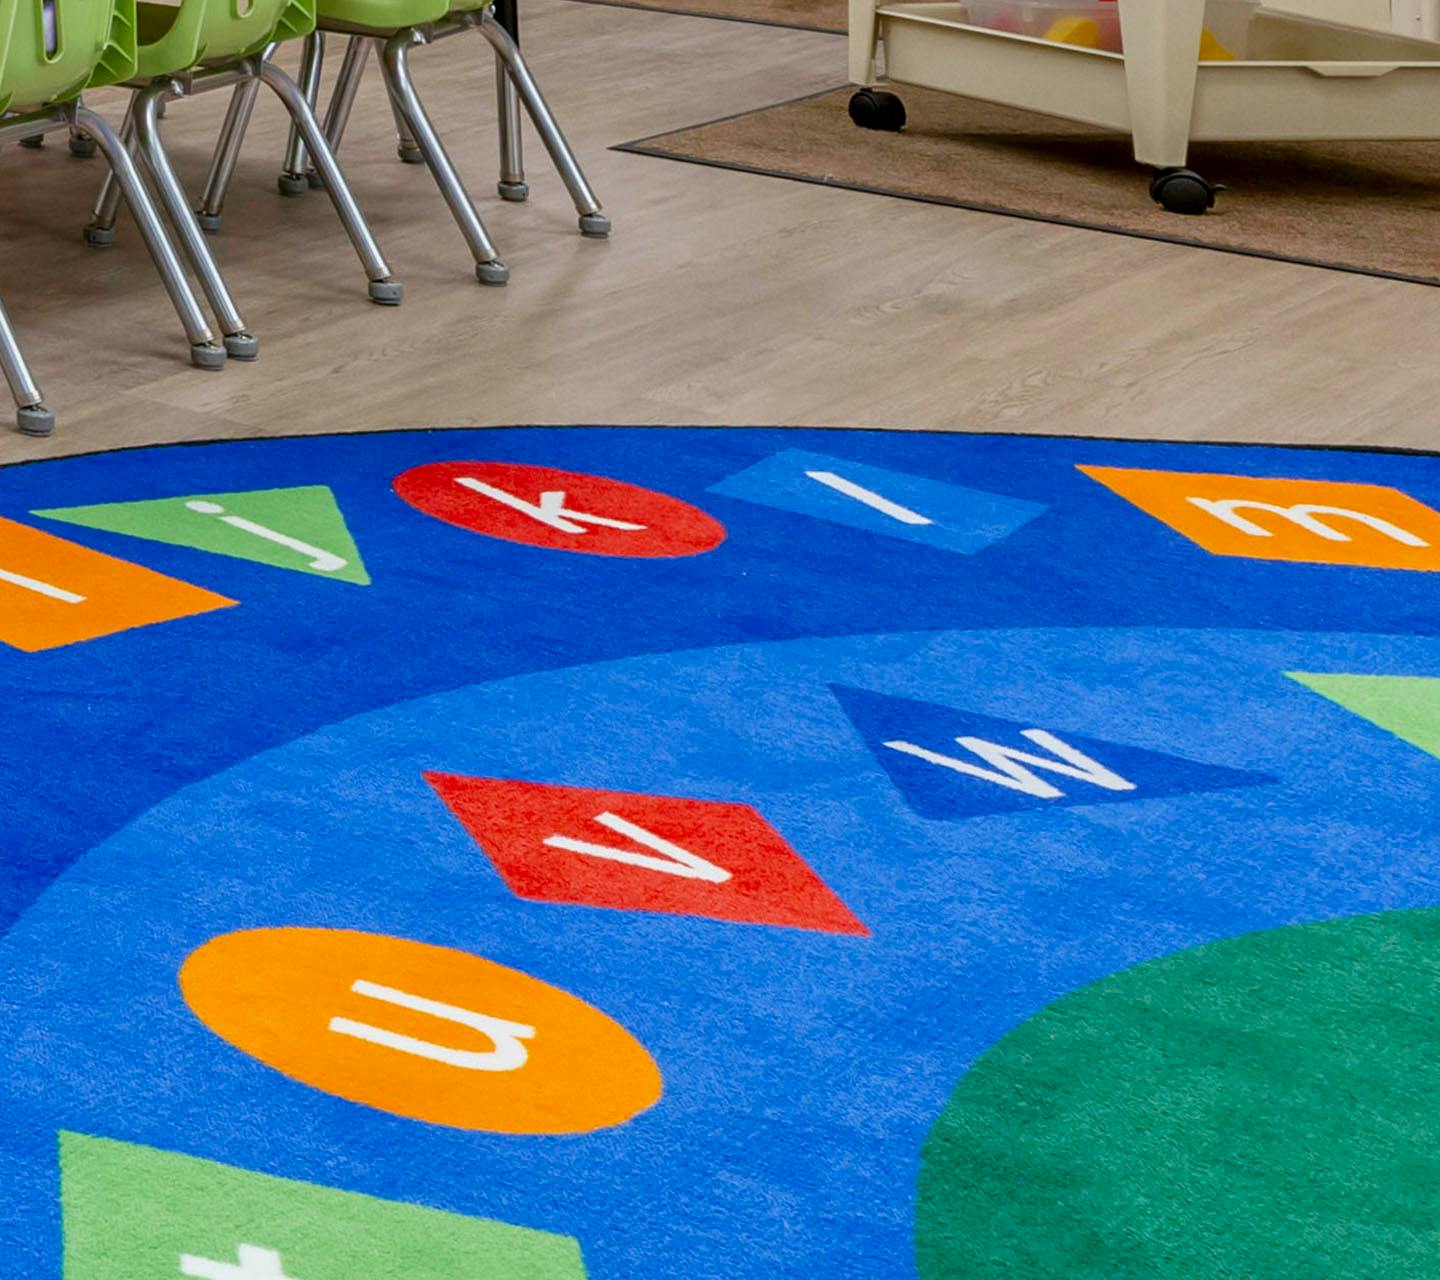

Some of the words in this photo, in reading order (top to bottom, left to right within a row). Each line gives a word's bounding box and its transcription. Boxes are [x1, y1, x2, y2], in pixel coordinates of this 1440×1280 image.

[185, 498, 350, 573] j
[458, 478, 640, 533] k
[1185, 496, 1431, 547] m
[330, 980, 534, 1071] u
